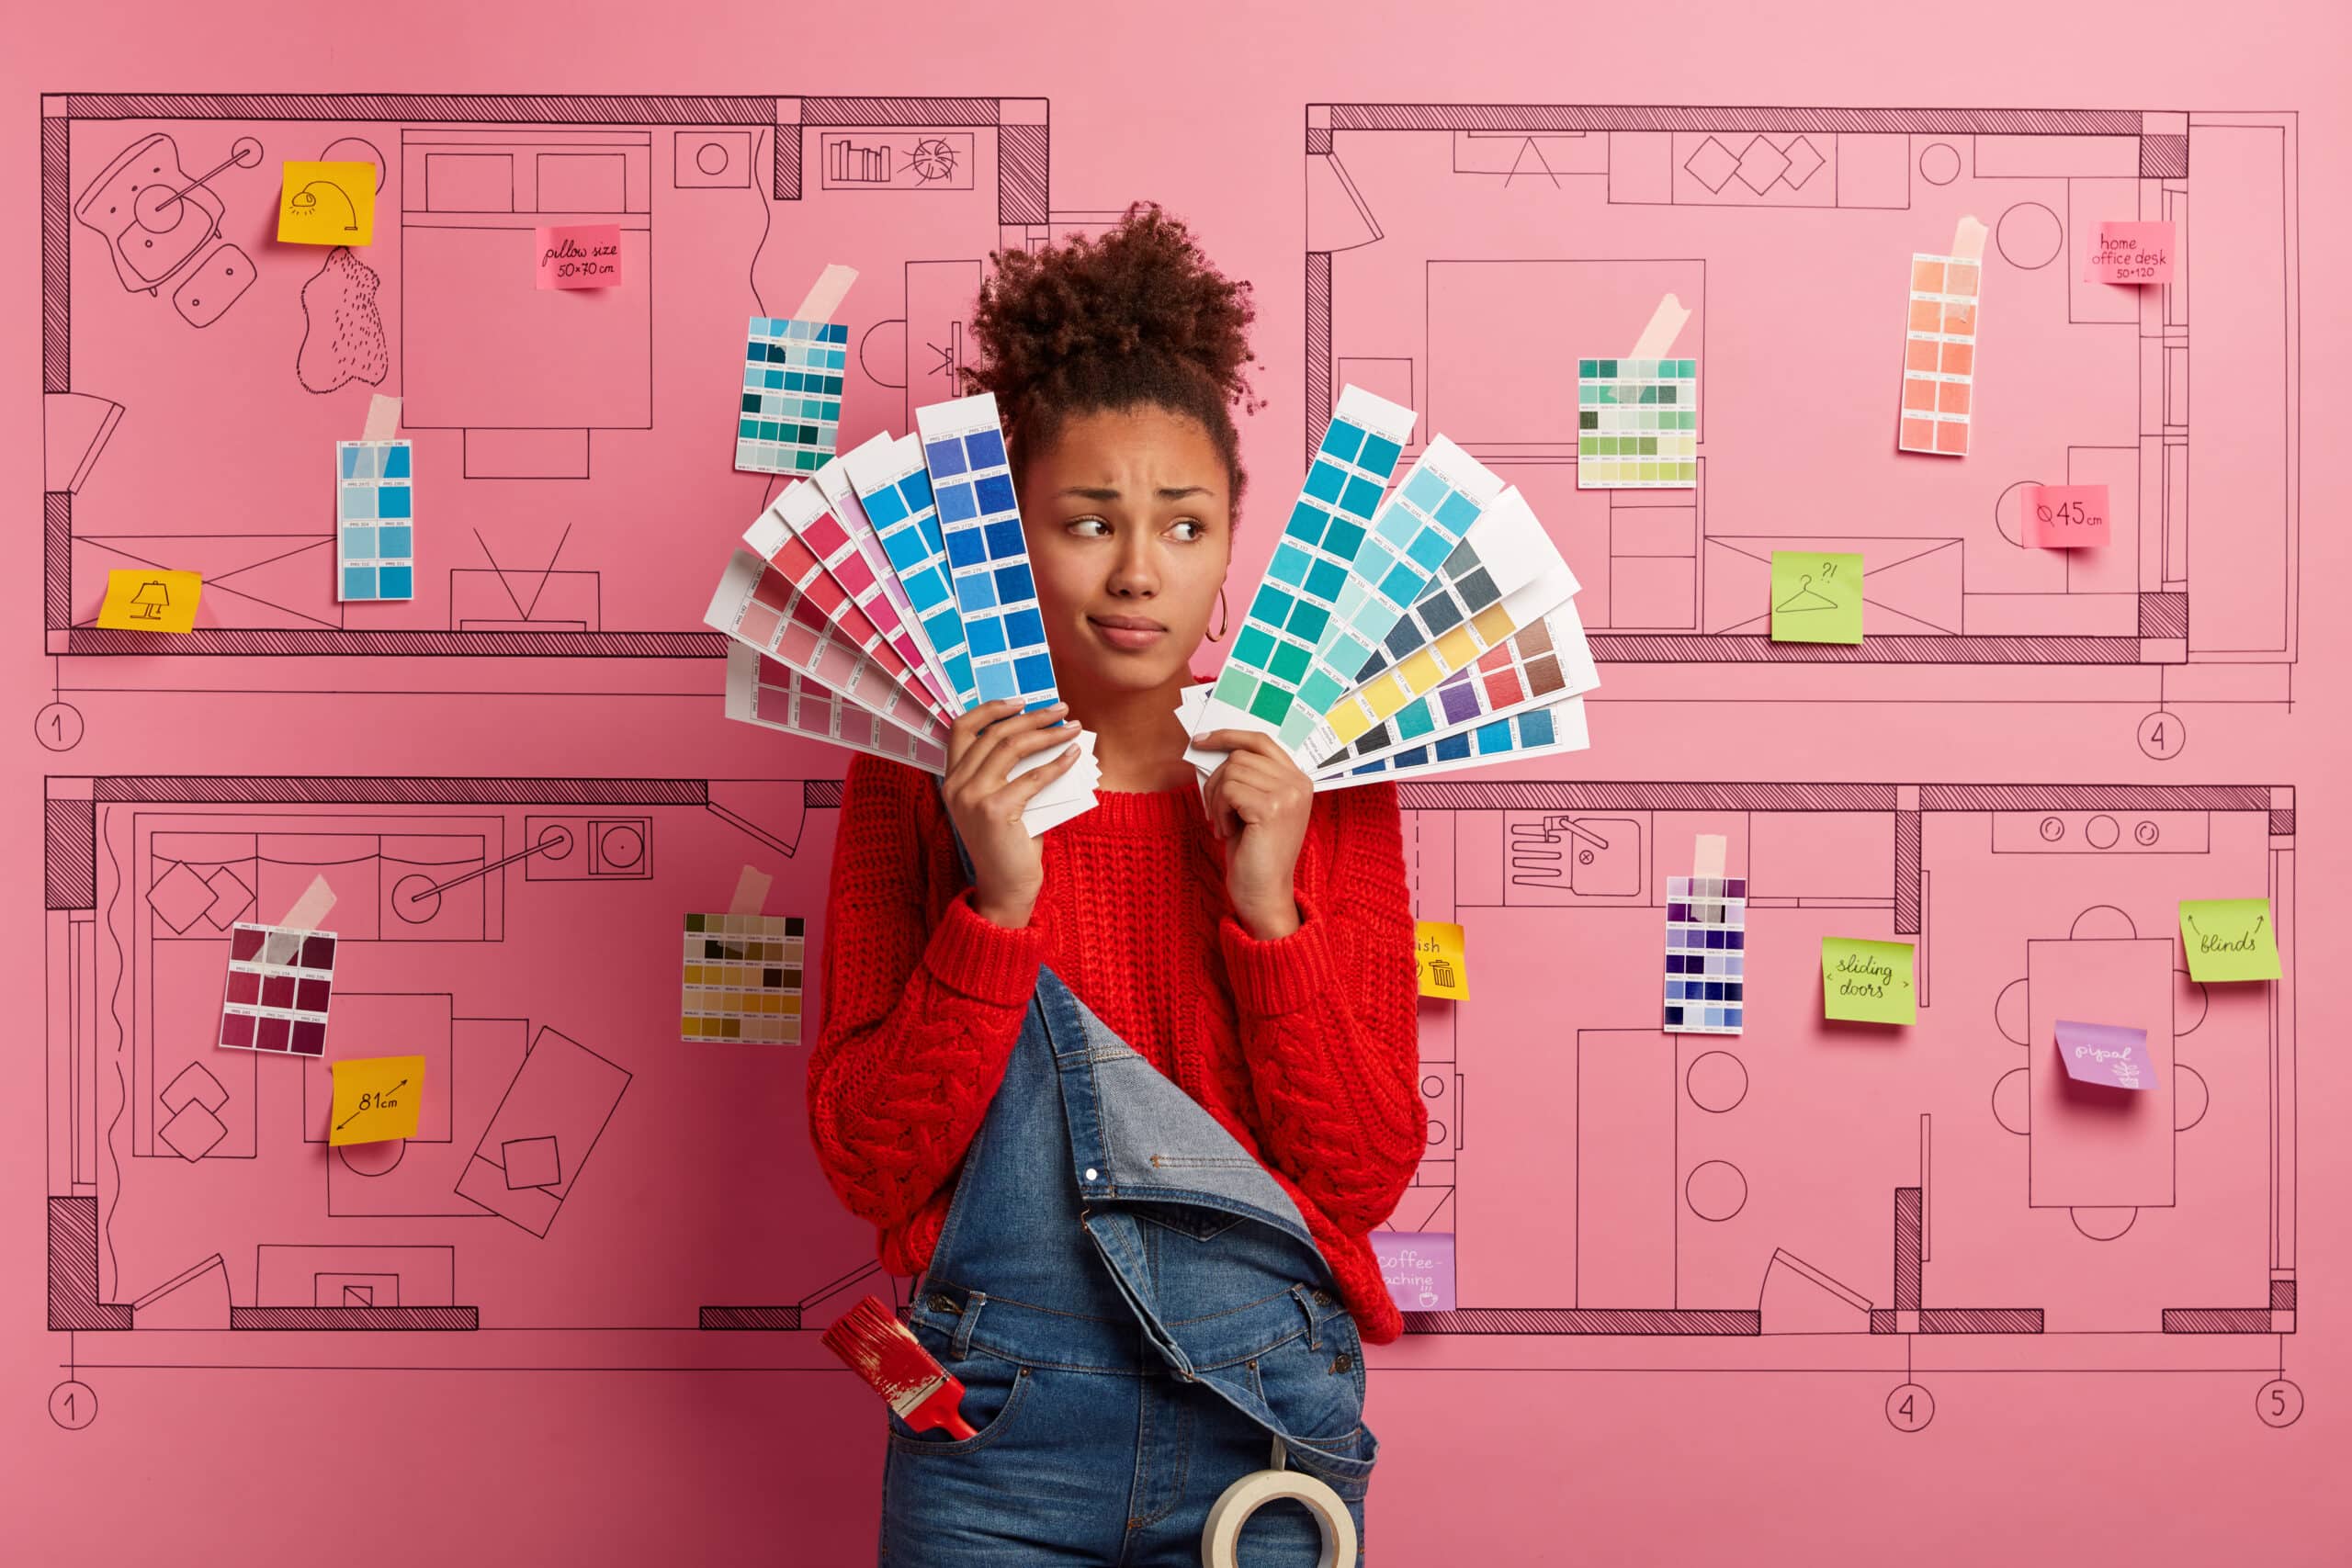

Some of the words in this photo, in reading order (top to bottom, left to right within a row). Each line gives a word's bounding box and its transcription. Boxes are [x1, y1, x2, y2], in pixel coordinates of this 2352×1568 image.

[542, 239, 587, 267] pillow
[593, 242, 617, 257] size
[2100, 232, 2137, 250] home
[2092, 251, 2132, 265] office
[2135, 248, 2166, 266] desk
[599, 265, 615, 274] cm
[51, 714, 62, 741] 1
[2151, 721, 2165, 750] 4
[1418, 936, 1440, 953] ish
[2200, 931, 2256, 954] blinds
[1837, 953, 1893, 986] sliding
[1840, 978, 1883, 999] doors
[1384, 1271, 1433, 1286] achine
[63, 1393, 74, 1421] 1
[1899, 1394, 1913, 1423] 4
[2272, 1390, 2285, 1416] 5
